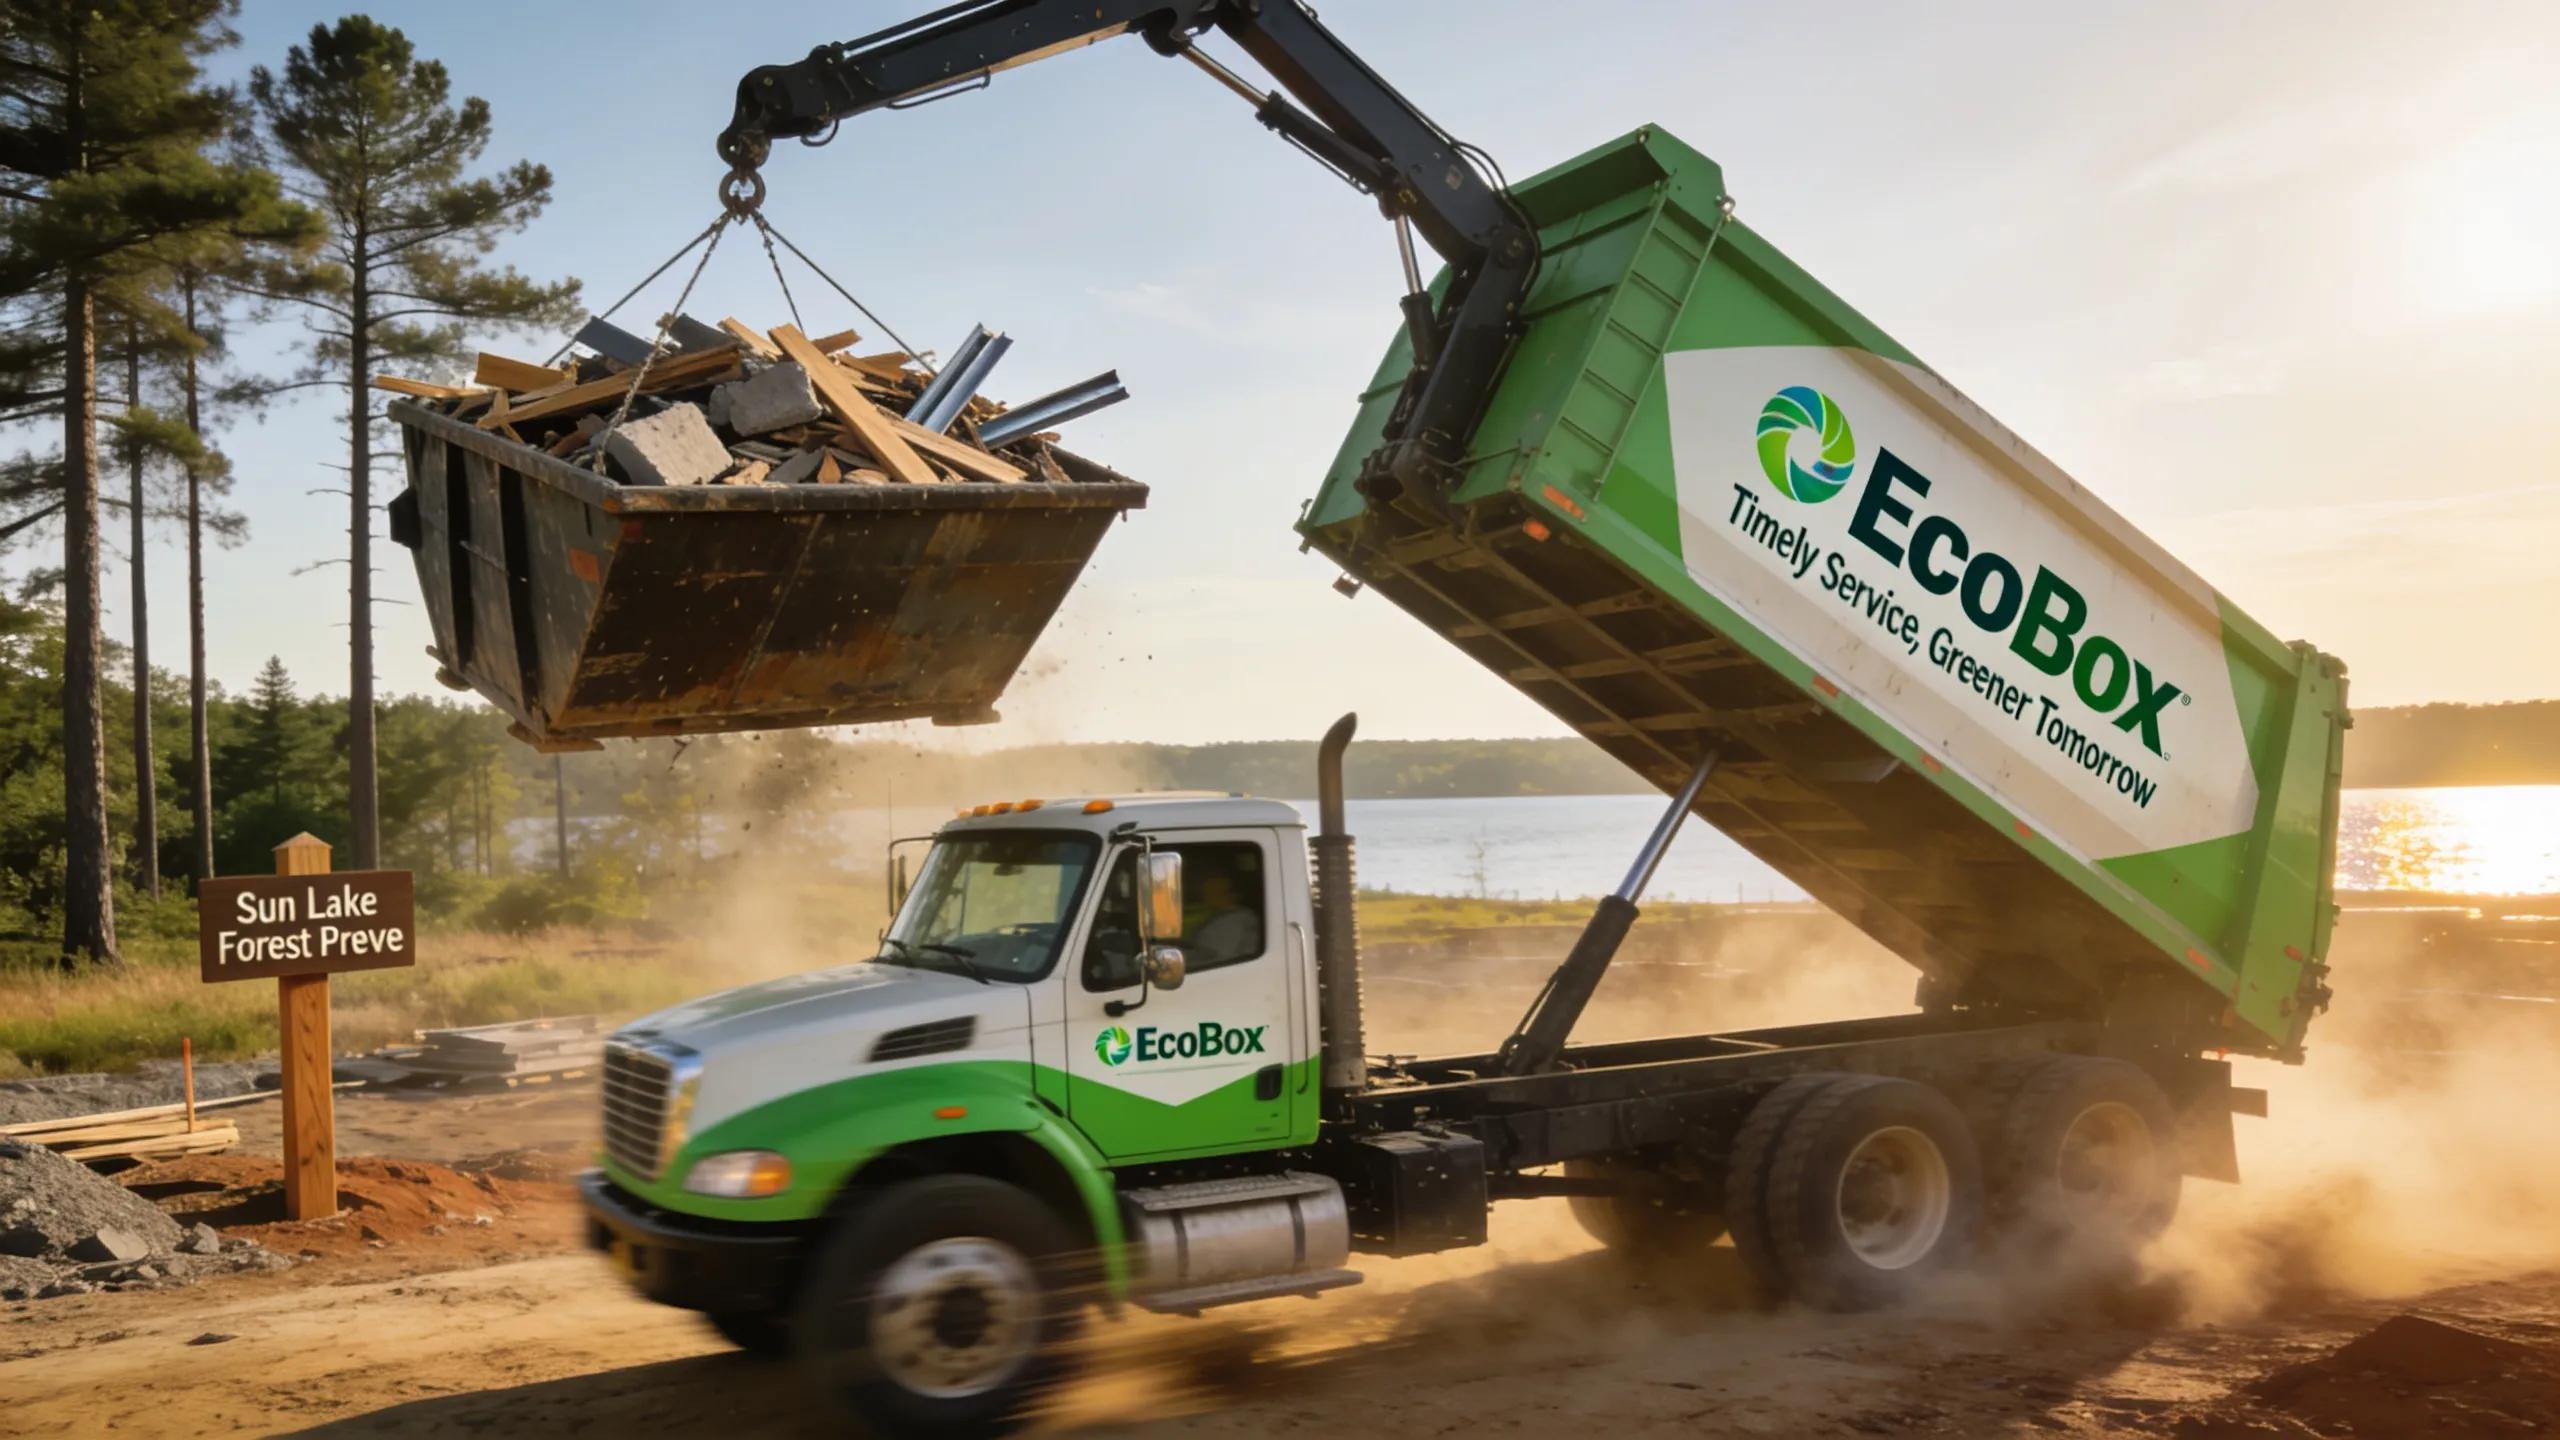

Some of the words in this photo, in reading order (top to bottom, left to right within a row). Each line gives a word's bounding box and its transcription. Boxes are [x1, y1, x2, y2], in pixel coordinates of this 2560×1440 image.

[1728, 482, 1821, 580] Timely
[1820, 551, 1920, 656] Service,
[1928, 627, 2034, 722] Greener
[2036, 695, 2158, 809] Tomorrow
[236, 891, 296, 924] Sun
[307, 884, 378, 919] Lake
[218, 927, 313, 965] Forest
[320, 925, 404, 957] Preve
